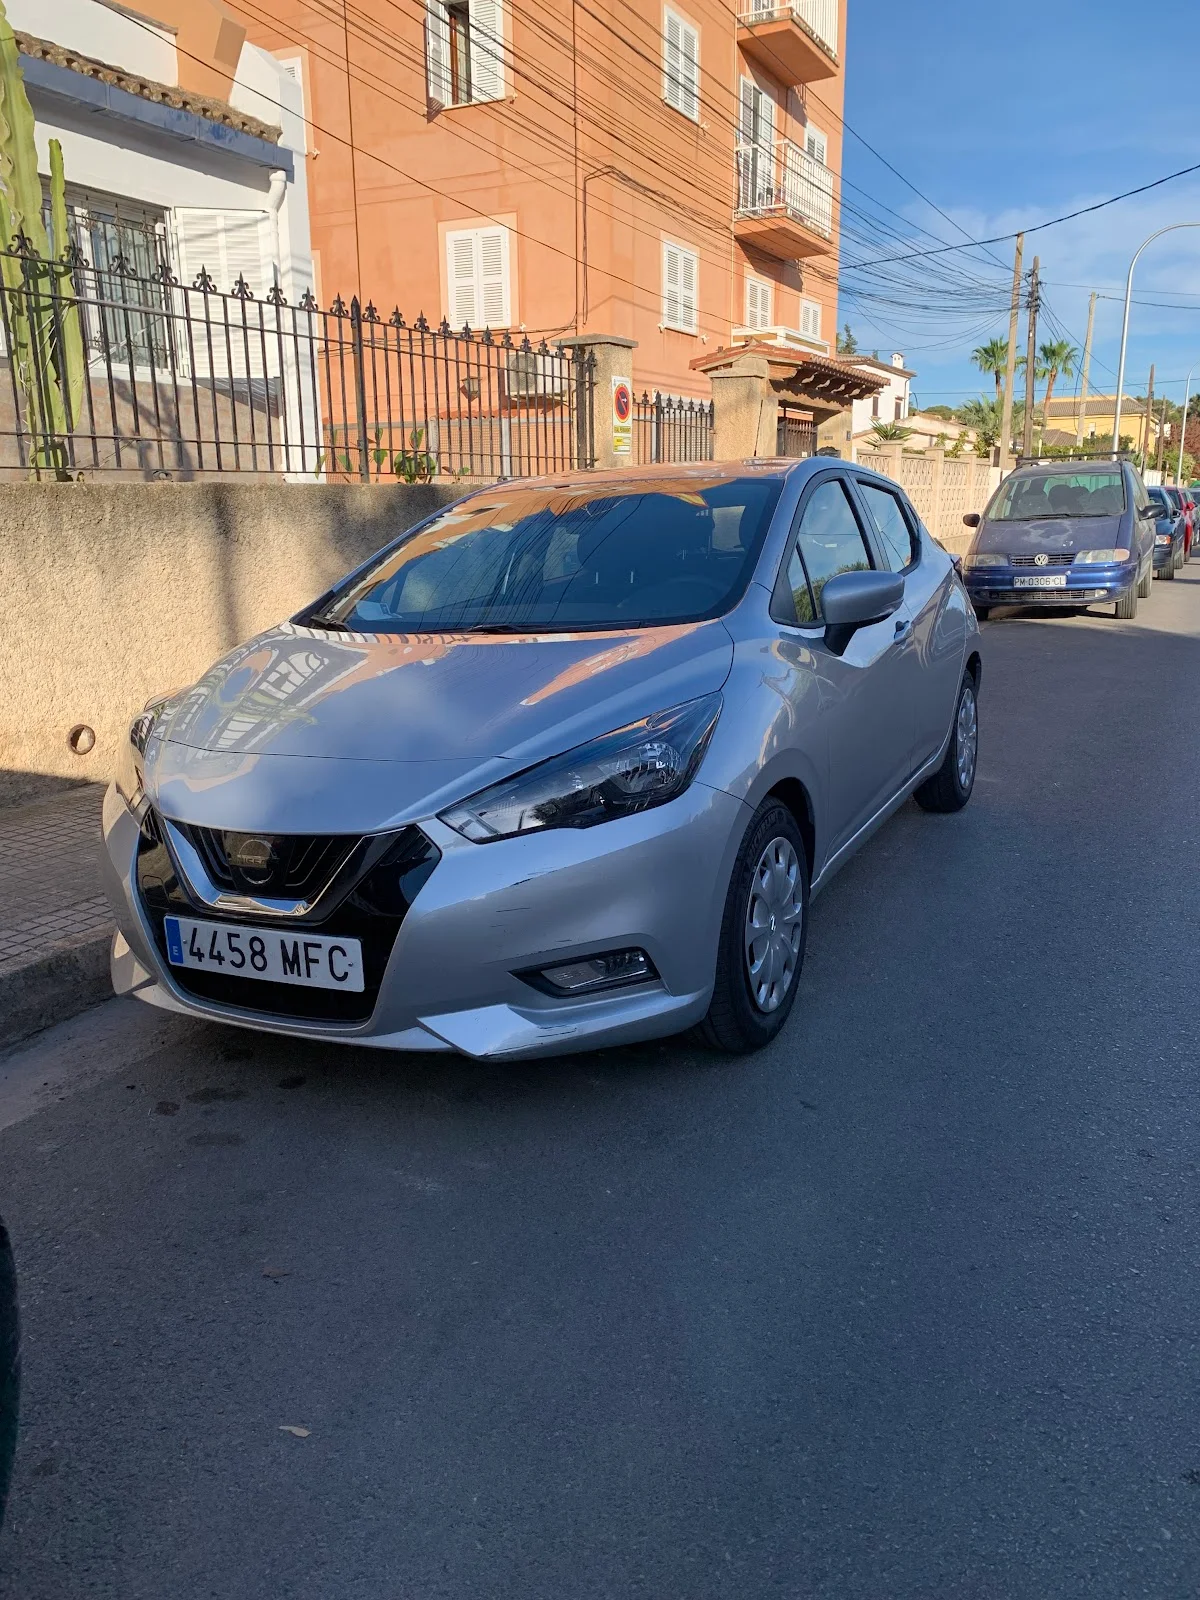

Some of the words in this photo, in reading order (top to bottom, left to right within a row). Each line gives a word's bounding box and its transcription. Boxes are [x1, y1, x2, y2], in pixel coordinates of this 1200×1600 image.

[172, 945, 179, 956] E
[189, 927, 268, 972] 4458
[280, 939, 349, 982] MFC
